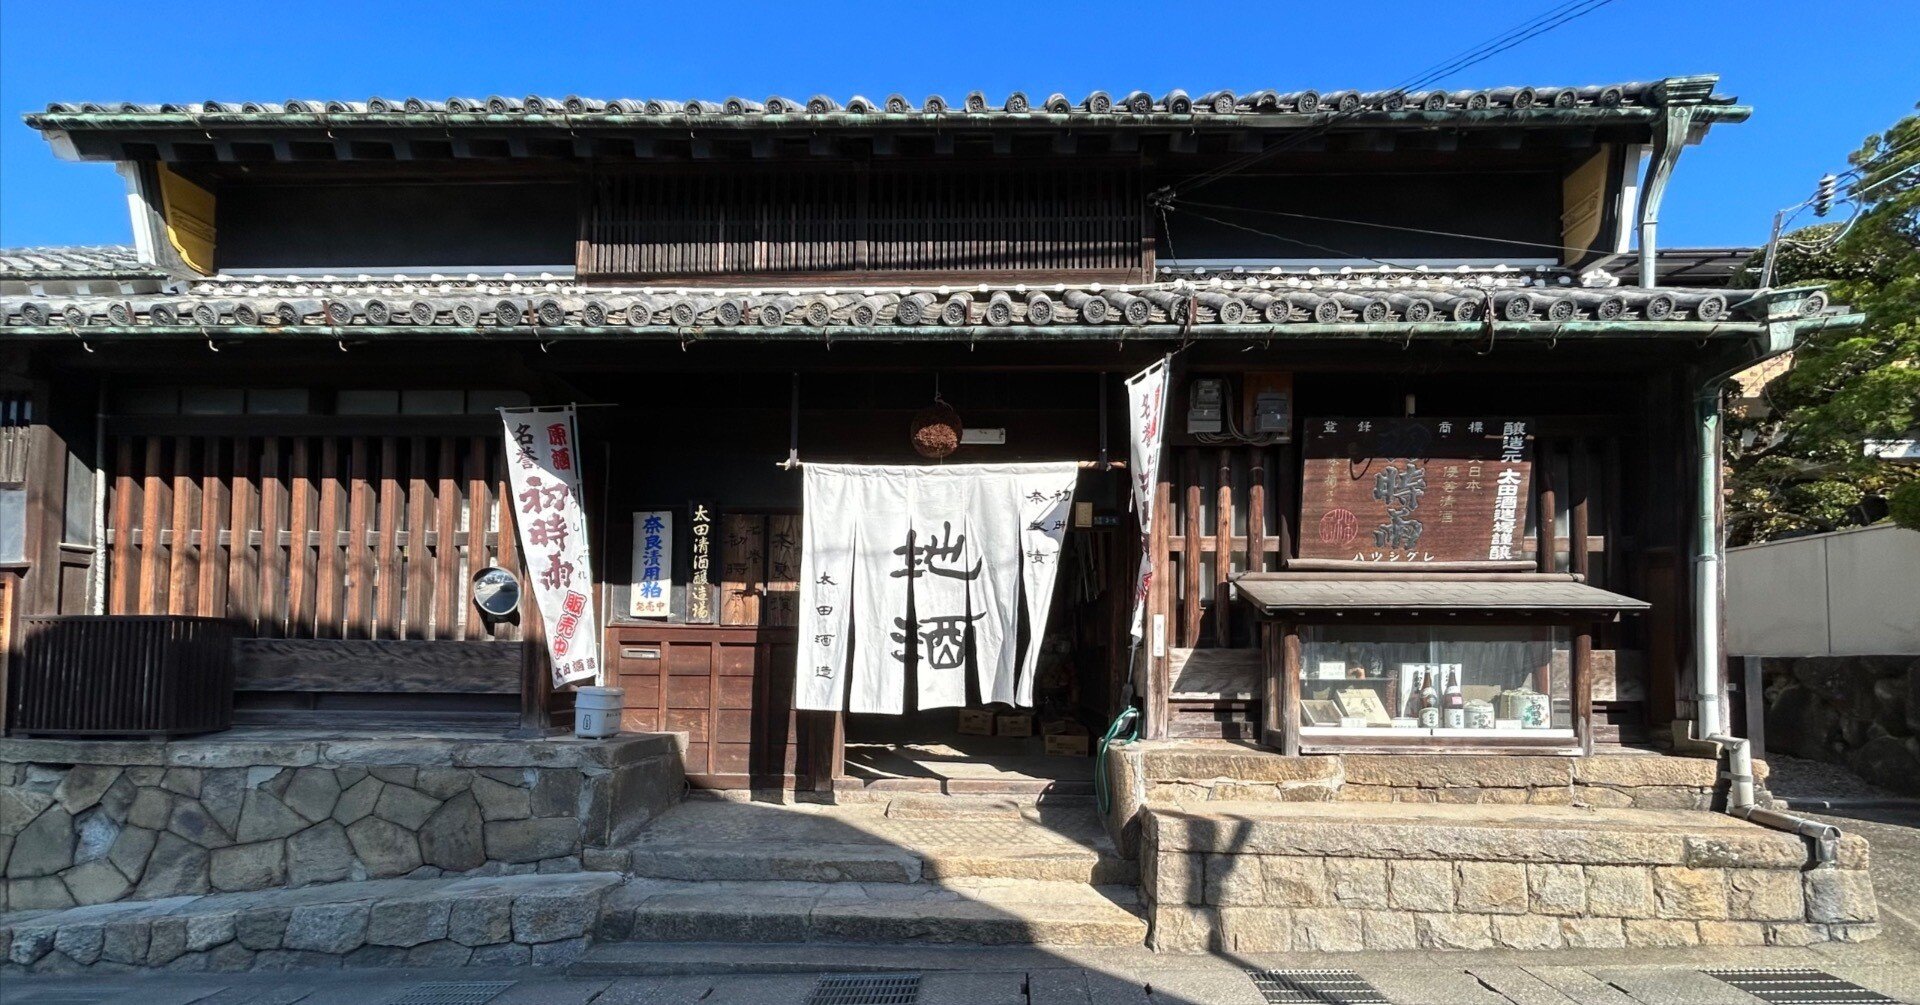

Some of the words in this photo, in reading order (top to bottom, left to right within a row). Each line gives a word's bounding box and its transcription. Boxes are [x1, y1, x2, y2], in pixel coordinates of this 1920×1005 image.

[546, 422, 571, 471] 原酒
[519, 475, 575, 592] 初時雨
[640, 514, 665, 599] 奈良漬用粕
[1353, 551, 1435, 563] ハツシグレ
[552, 590, 587, 660] 販売中
[814, 571, 838, 680] 太田酒造
[890, 520, 987, 669] 地酒
